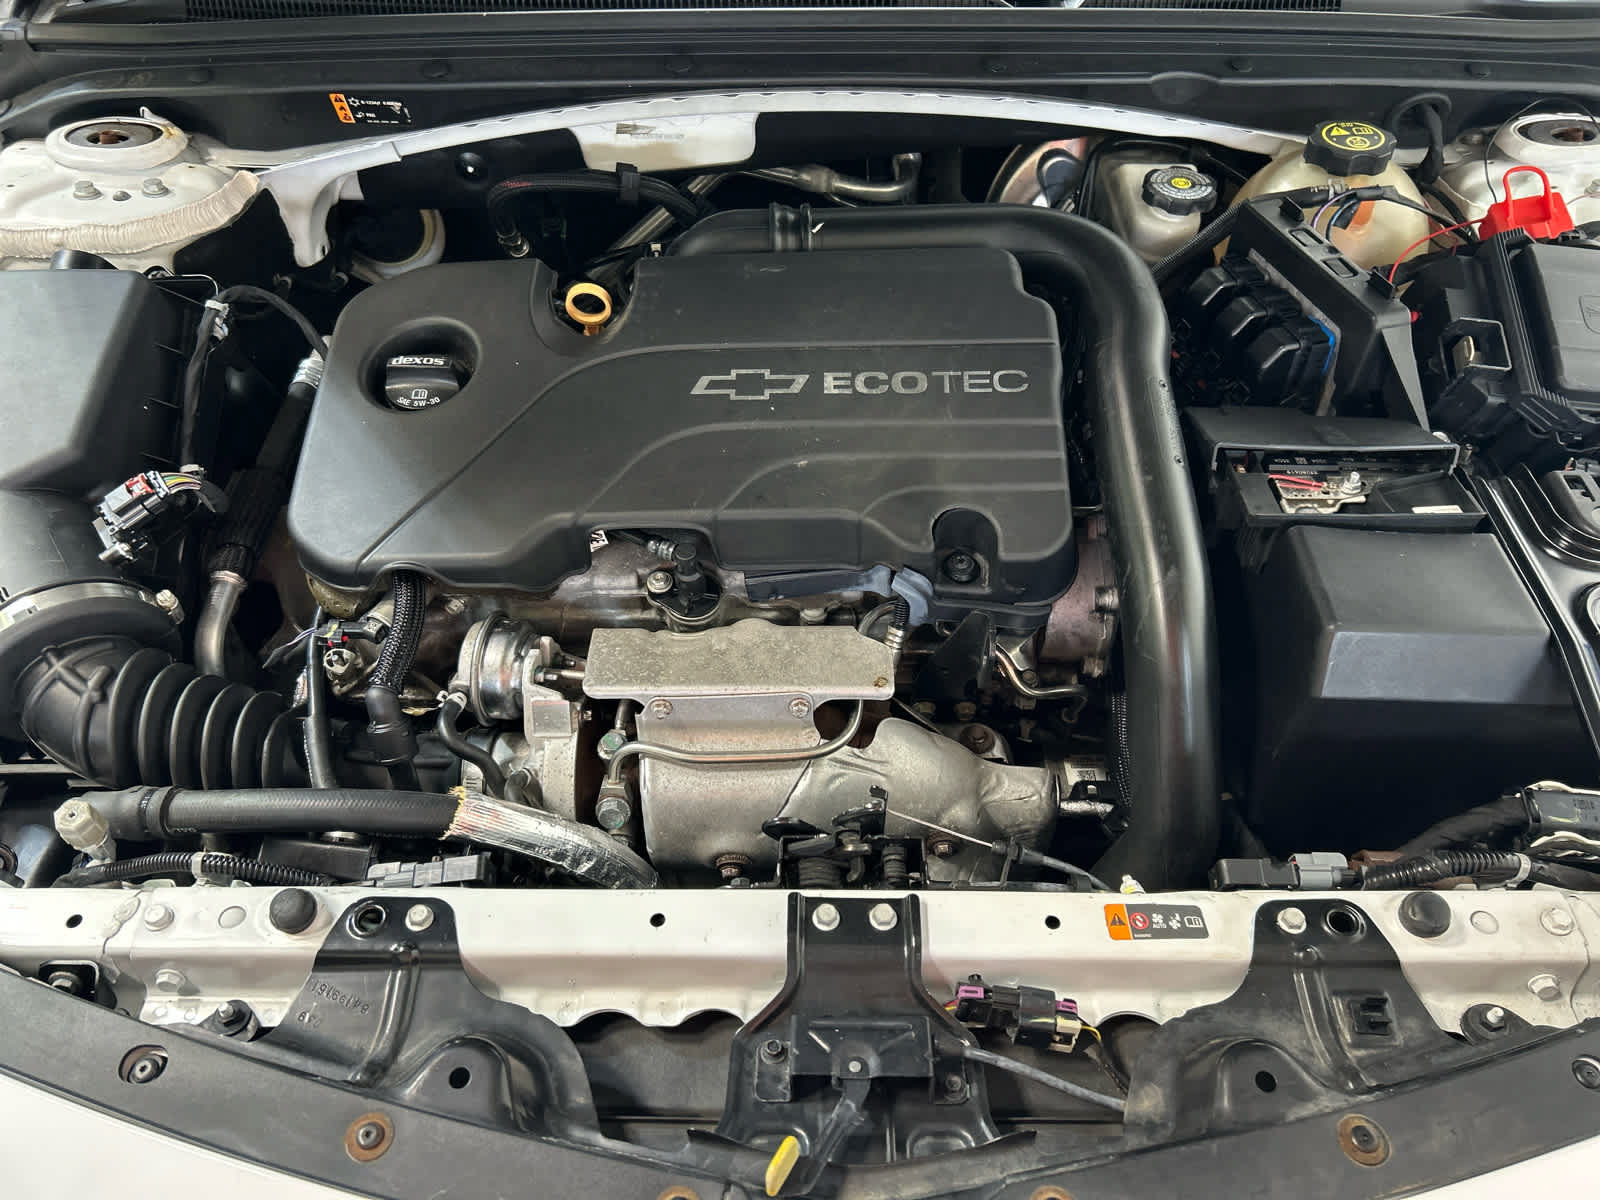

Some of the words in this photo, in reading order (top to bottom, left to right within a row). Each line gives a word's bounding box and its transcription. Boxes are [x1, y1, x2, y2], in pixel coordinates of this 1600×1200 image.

[391, 355, 445, 366] dexos
[823, 370, 1029, 395] ECOTEC
[396, 396, 412, 406] SAE
[413, 396, 441, 407] 5W-30
